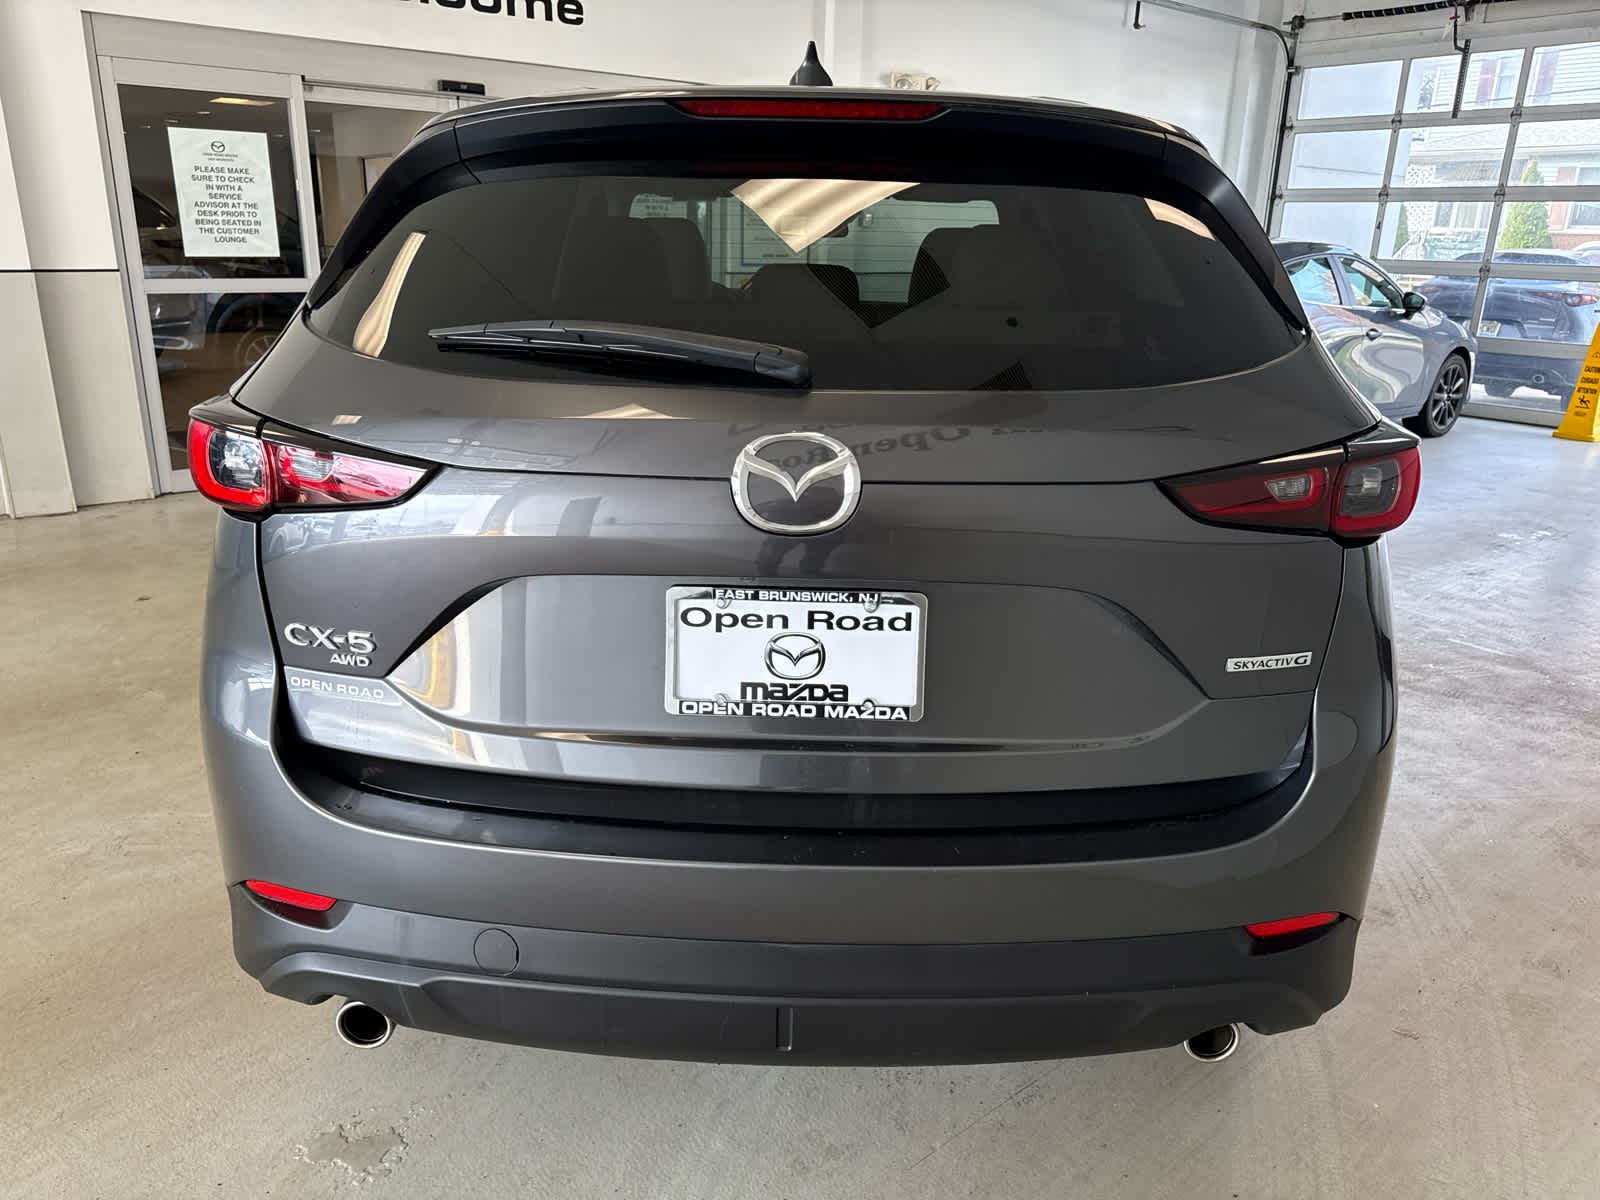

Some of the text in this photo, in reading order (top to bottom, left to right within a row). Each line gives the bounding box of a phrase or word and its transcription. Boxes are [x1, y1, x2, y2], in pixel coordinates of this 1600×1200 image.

[403, 0, 584, 25] ome
[194, 165, 250, 175] PLEASE MAKE
[191, 174, 213, 182] SURE
[228, 176, 255, 184] CHECK
[194, 201, 229, 209] ADVISOR
[243, 202, 258, 210] THE
[216, 227, 260, 235] CUSTOMER
[715, 589, 879, 603] EAST BRUNSWICK, NJ
[680, 607, 912, 632] Open Road
[284, 622, 376, 653] CX-5
[329, 653, 371, 667] AWD
[290, 676, 384, 699] OPEN ROAD
[681, 700, 908, 720] OPEN ROAD MAZDA
